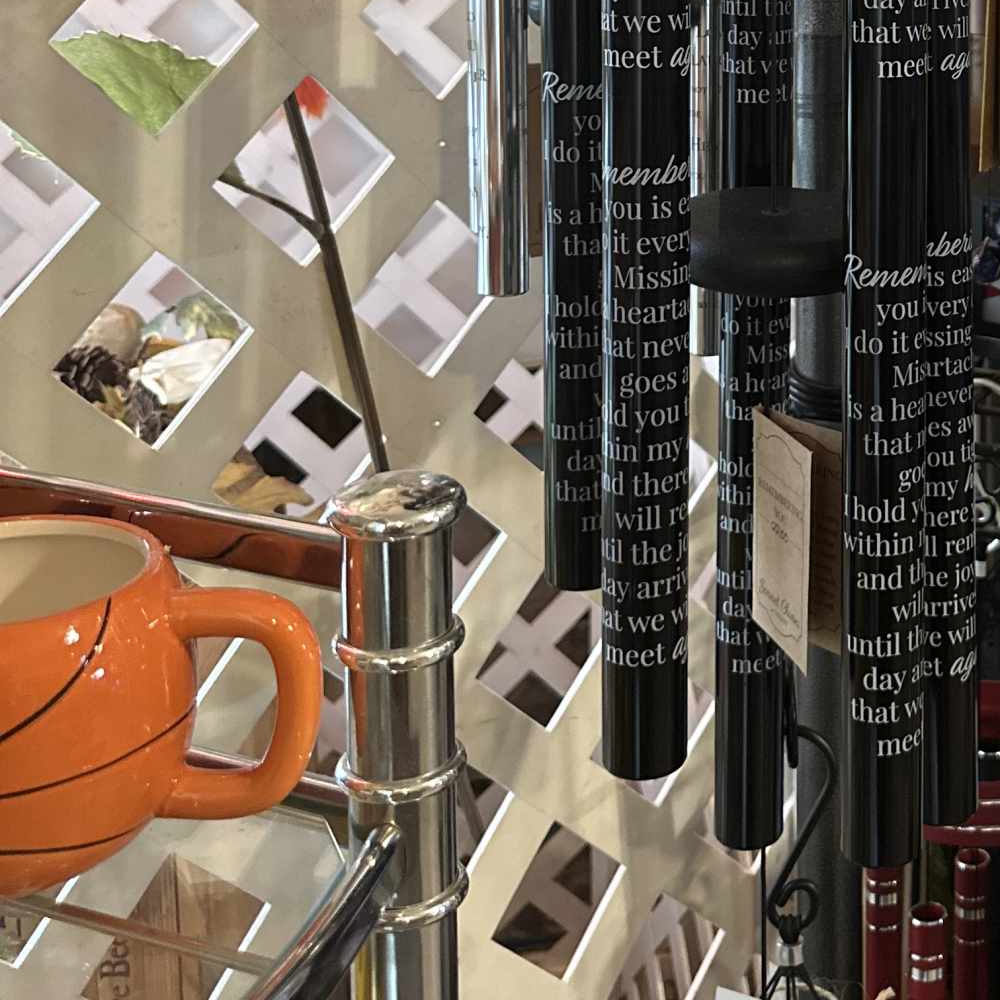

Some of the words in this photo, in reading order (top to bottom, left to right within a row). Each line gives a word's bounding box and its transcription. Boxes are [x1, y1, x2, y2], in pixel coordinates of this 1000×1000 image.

[624, 15, 660, 33] we
[728, 24, 762, 48] day
[852, 18, 900, 44] that
[604, 47, 663, 68] meet
[553, 141, 580, 163] do
[548, 202, 561, 224] is
[570, 206, 581, 225] a
[651, 196, 671, 219] is
[613, 230, 628, 254] it
[875, 300, 918, 326] you
[854, 329, 882, 354] do
[891, 330, 909, 353] it
[620, 371, 676, 397] goes
[848, 394, 862, 419] is
[870, 406, 884, 422] a
[634, 409, 679, 433] you
[648, 440, 684, 464] my
[864, 432, 912, 456] that
[616, 507, 660, 532] will
[853, 497, 905, 523] hold
[632, 542, 671, 566] the
[843, 530, 913, 557] within
[857, 565, 902, 590] and
[628, 614, 664, 633] we
[716, 619, 750, 645] that
[606, 643, 665, 668] meet
[847, 632, 900, 657] until
[732, 648, 782, 674] meet
[863, 668, 908, 694] day
[851, 698, 900, 724] that
